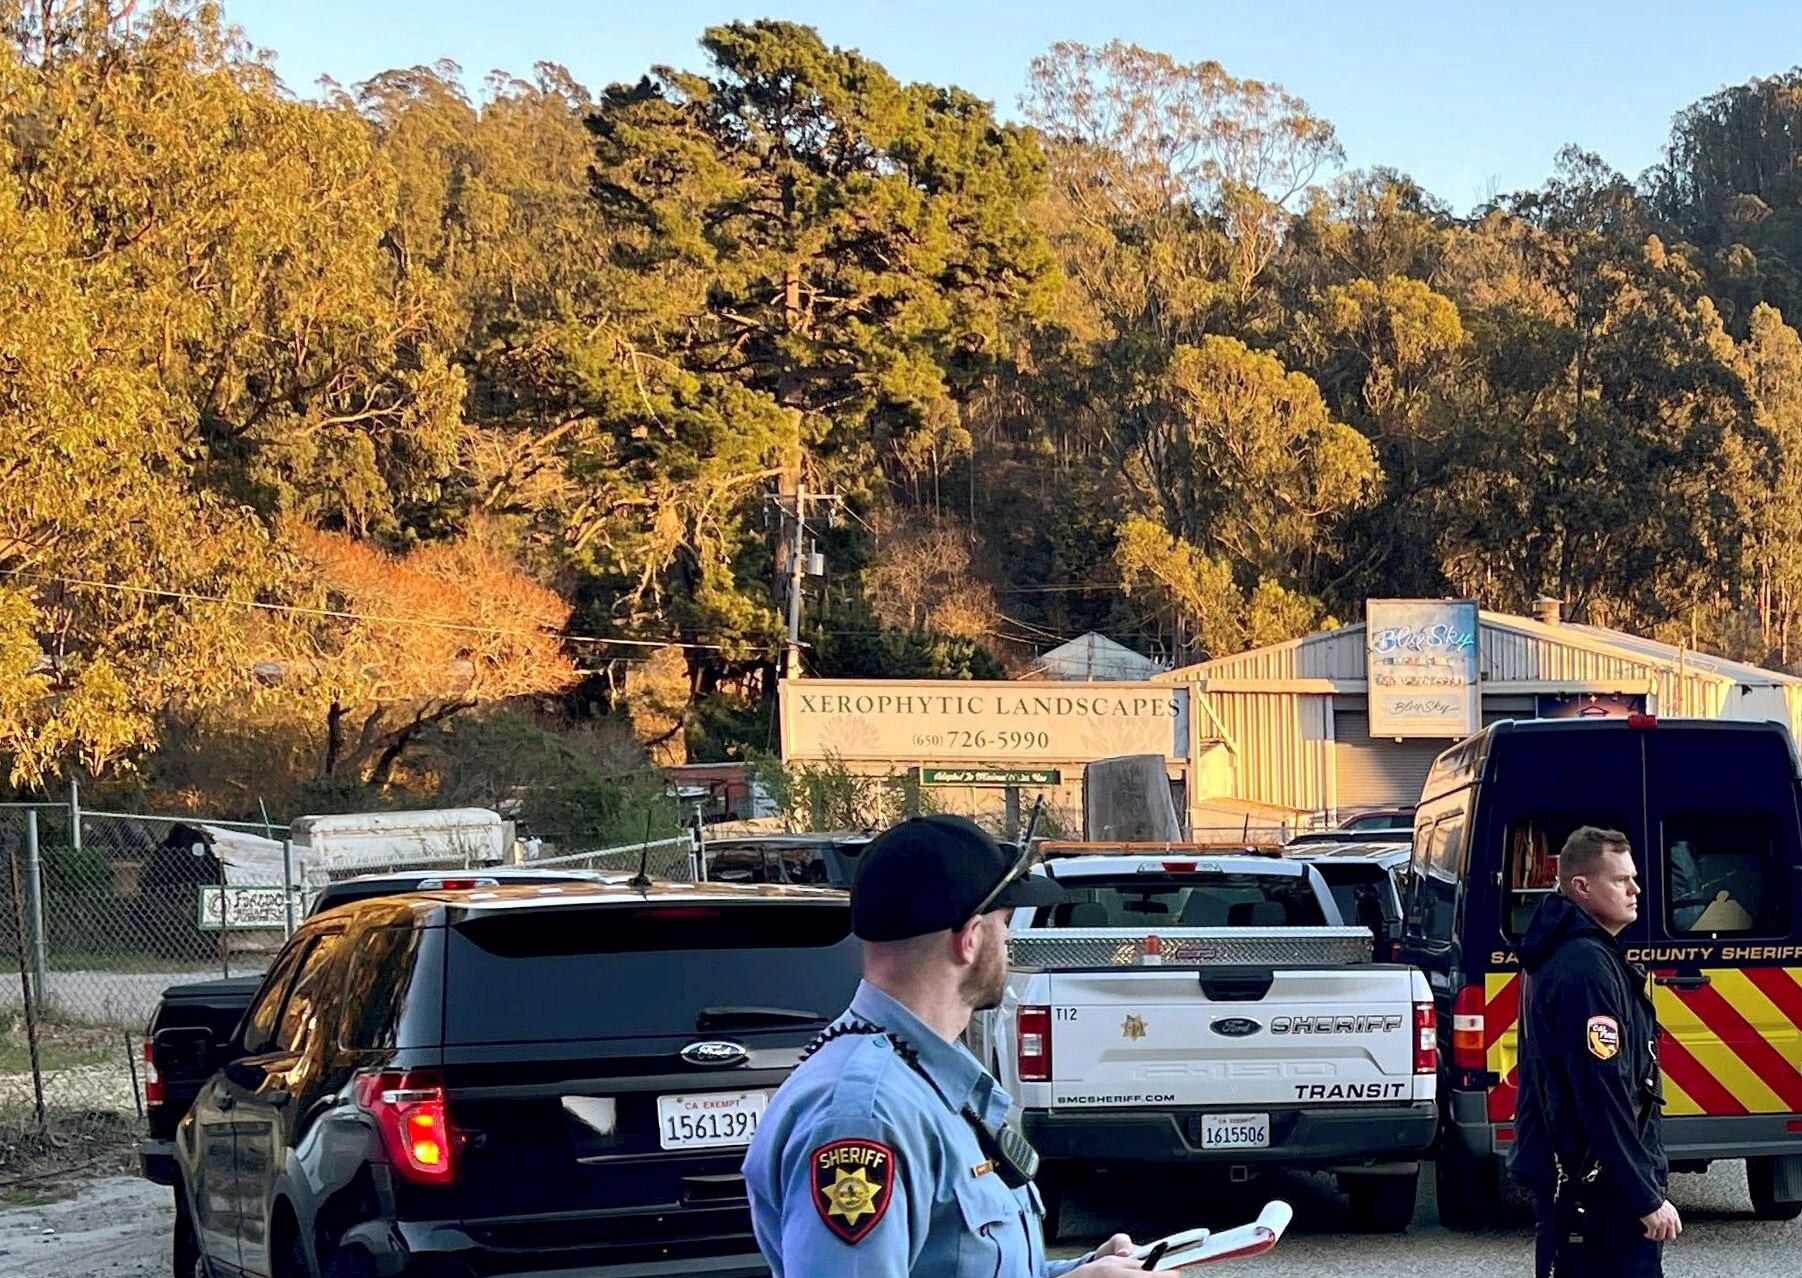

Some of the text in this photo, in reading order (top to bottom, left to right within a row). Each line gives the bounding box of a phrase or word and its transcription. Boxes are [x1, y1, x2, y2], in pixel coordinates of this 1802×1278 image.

[1375, 624, 1474, 653] Blue Sky
[800, 695, 1181, 717] XEROPHYTIC LANDSCAPES
[912, 730, 1050, 750] (650) 726-5990
[1626, 947, 1714, 961] COUNTY
[1056, 1008, 1078, 1022] T12
[1270, 1015, 1403, 1035] SHERIFF
[1295, 1083, 1406, 1100] TRANSIT
[684, 1099, 741, 1110] CA EXEMPT
[667, 1111, 758, 1141] 1561391
[1206, 1126, 1265, 1144] 1615506
[820, 1147, 886, 1169] SHERIFF
